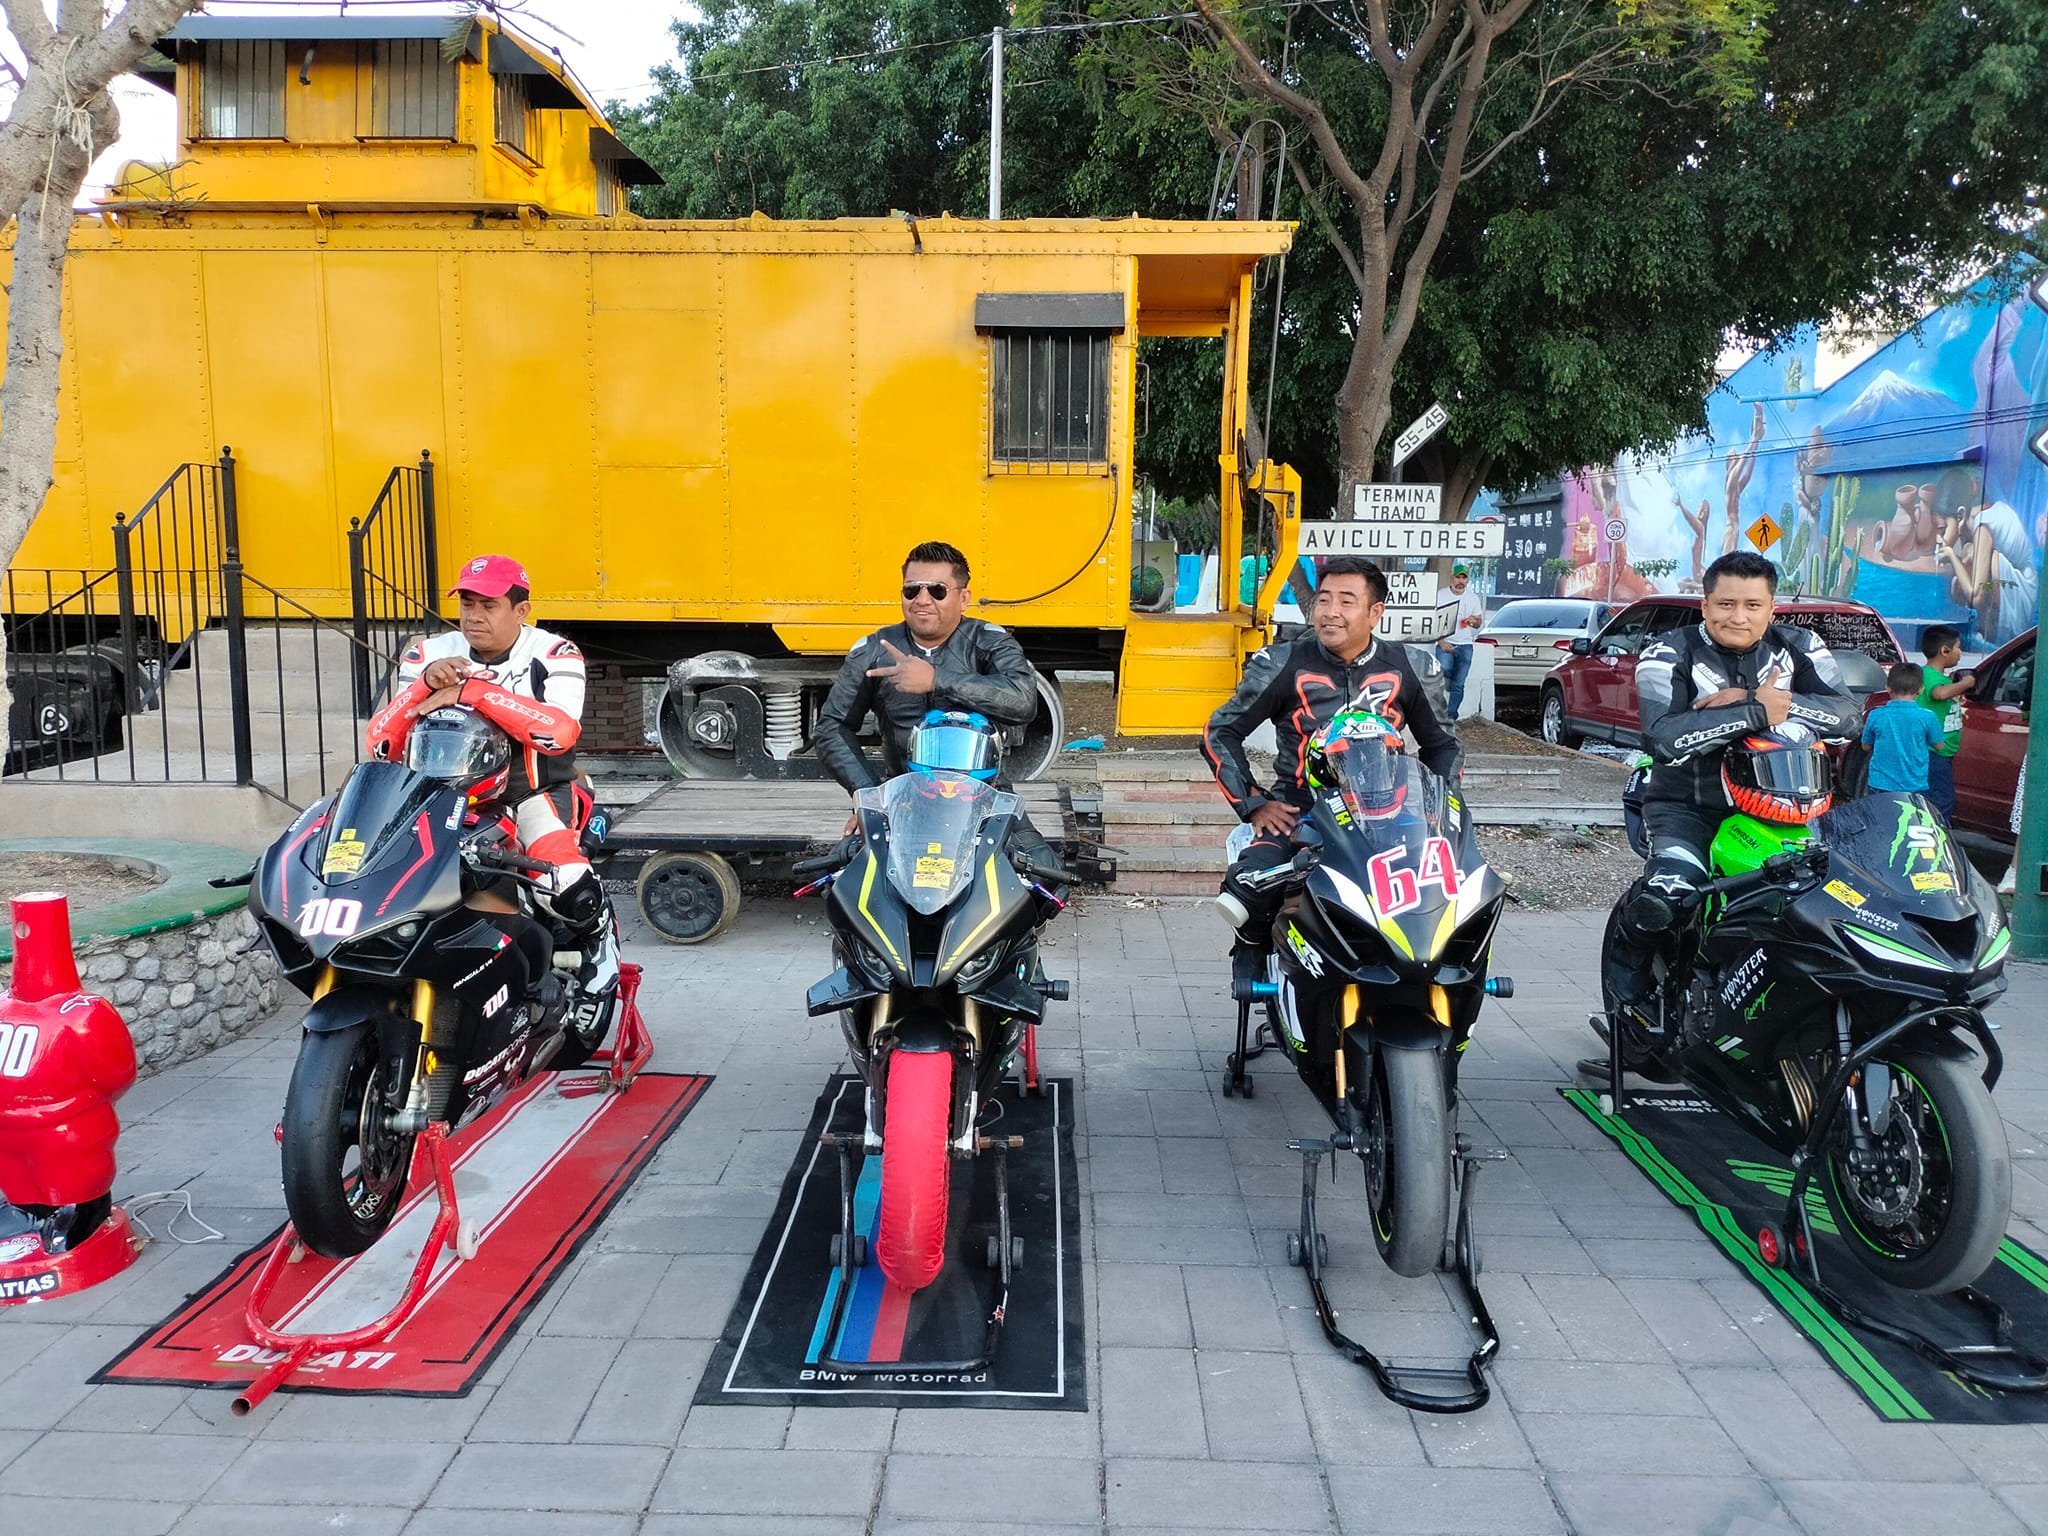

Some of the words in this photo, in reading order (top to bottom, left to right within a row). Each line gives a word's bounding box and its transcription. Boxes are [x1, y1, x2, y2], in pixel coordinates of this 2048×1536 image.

[1362, 488, 1436, 503] TERMINA
[1371, 506, 1426, 520] TRAMO
[1306, 529, 1486, 549] AVICULTORES
[1610, 530, 1621, 538] 30
[1386, 591, 1420, 605] AMO
[1380, 613, 1449, 635] UERTA
[1367, 837, 1465, 918] 64
[1730, 967, 1765, 1011] ENERGY
[216, 1344, 397, 1370] DUATI
[874, 1372, 987, 1383] Motorrad
